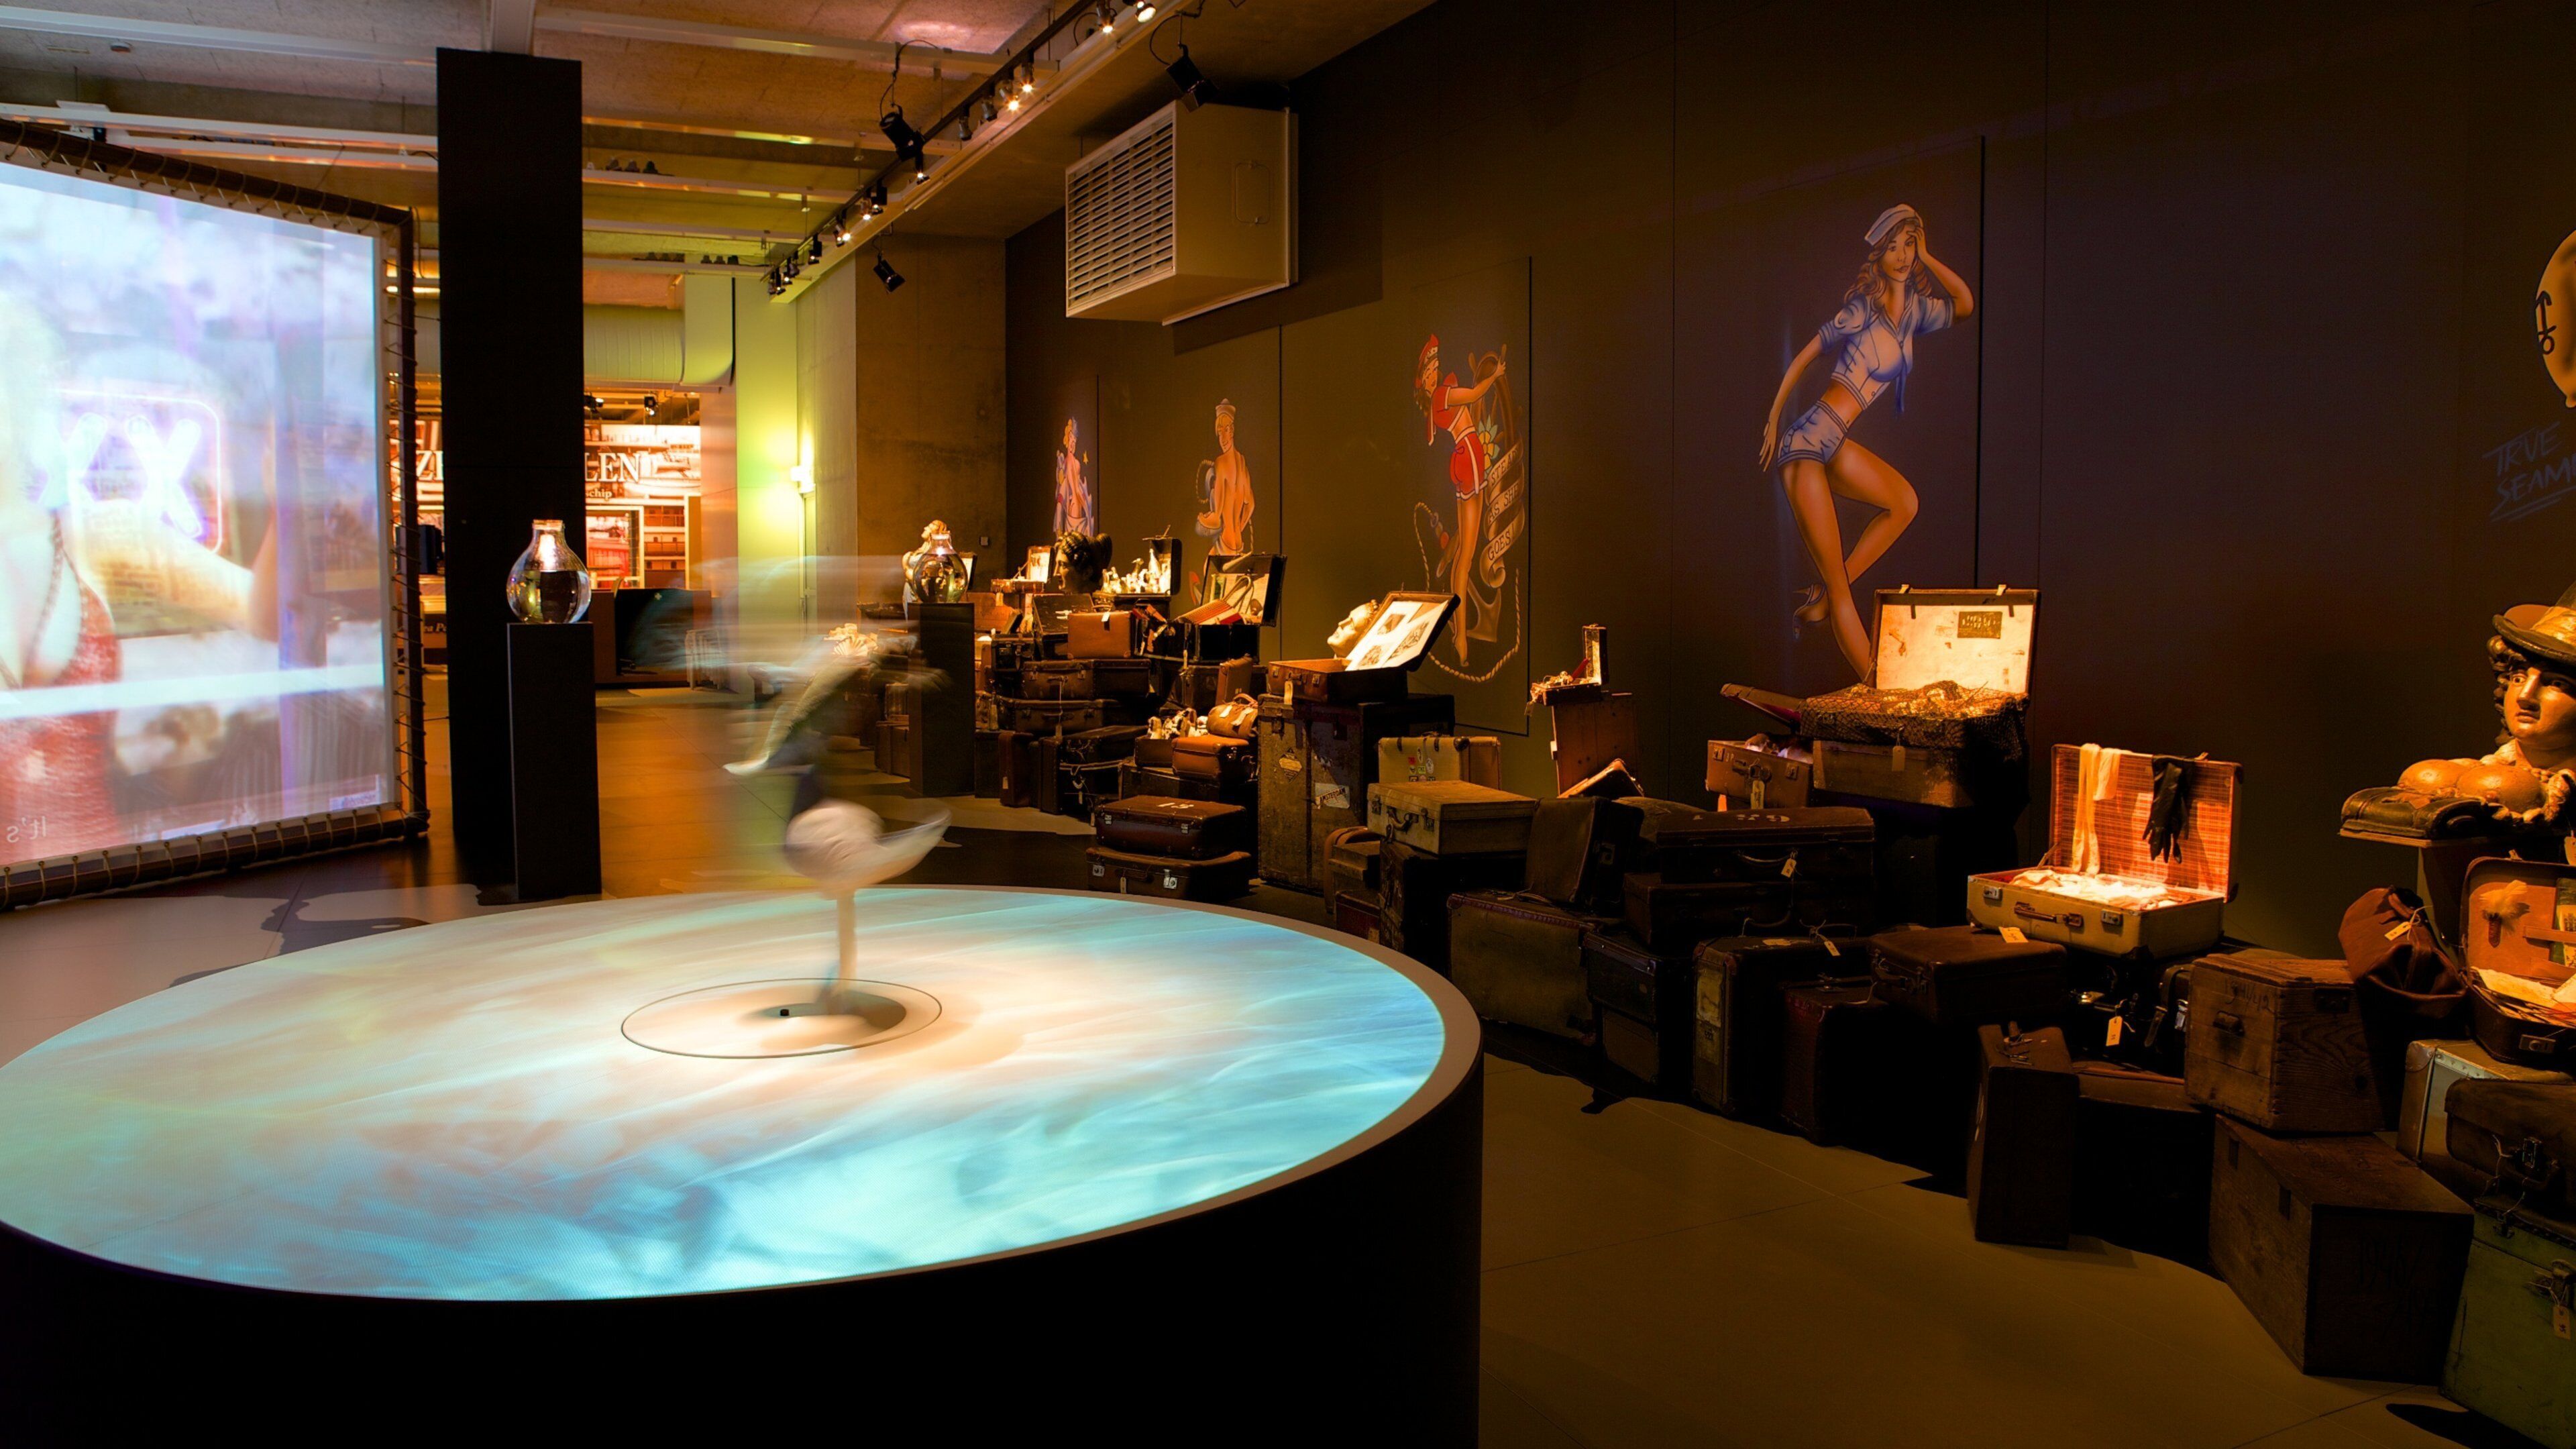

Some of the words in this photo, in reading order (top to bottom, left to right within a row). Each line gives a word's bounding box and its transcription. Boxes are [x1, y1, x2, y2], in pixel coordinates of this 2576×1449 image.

[2481, 421, 2563, 477] TRUE
[1488, 501, 1501, 525] AS
[1504, 484, 1519, 507] SHE
[2490, 452, 2576, 517] SEAM
